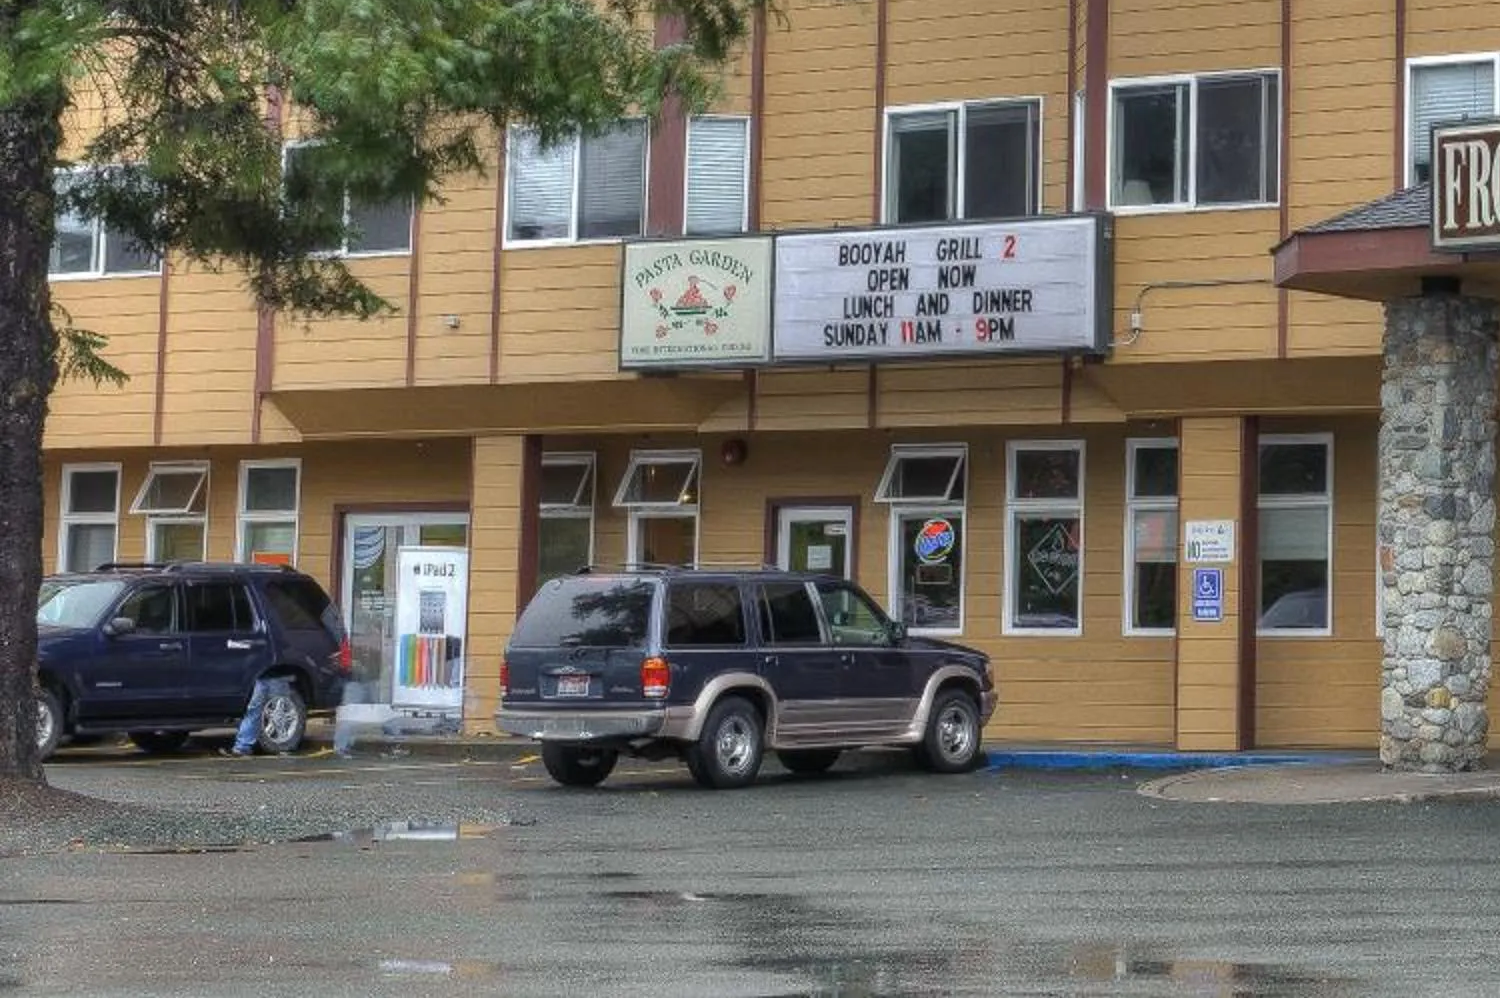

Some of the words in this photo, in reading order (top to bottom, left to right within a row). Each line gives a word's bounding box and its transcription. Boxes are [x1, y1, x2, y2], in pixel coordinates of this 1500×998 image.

[838, 241, 907, 266] BOOYAH
[936, 236, 983, 262] GRILL
[1003, 234, 1017, 260] 2
[635, 253, 683, 288] PASTA
[689, 249, 754, 285] GARDEN
[867, 268, 910, 292] OPEN
[937, 265, 978, 289] NOW
[843, 296, 895, 319] LUNCH
[915, 293, 950, 316] AND
[972, 289, 1033, 314] DINNER
[823, 322, 889, 347] SUNDAY
[901, 319, 943, 344] 11AM
[975, 316, 1016, 343] 9PM
[423, 563, 447, 577] iPad
